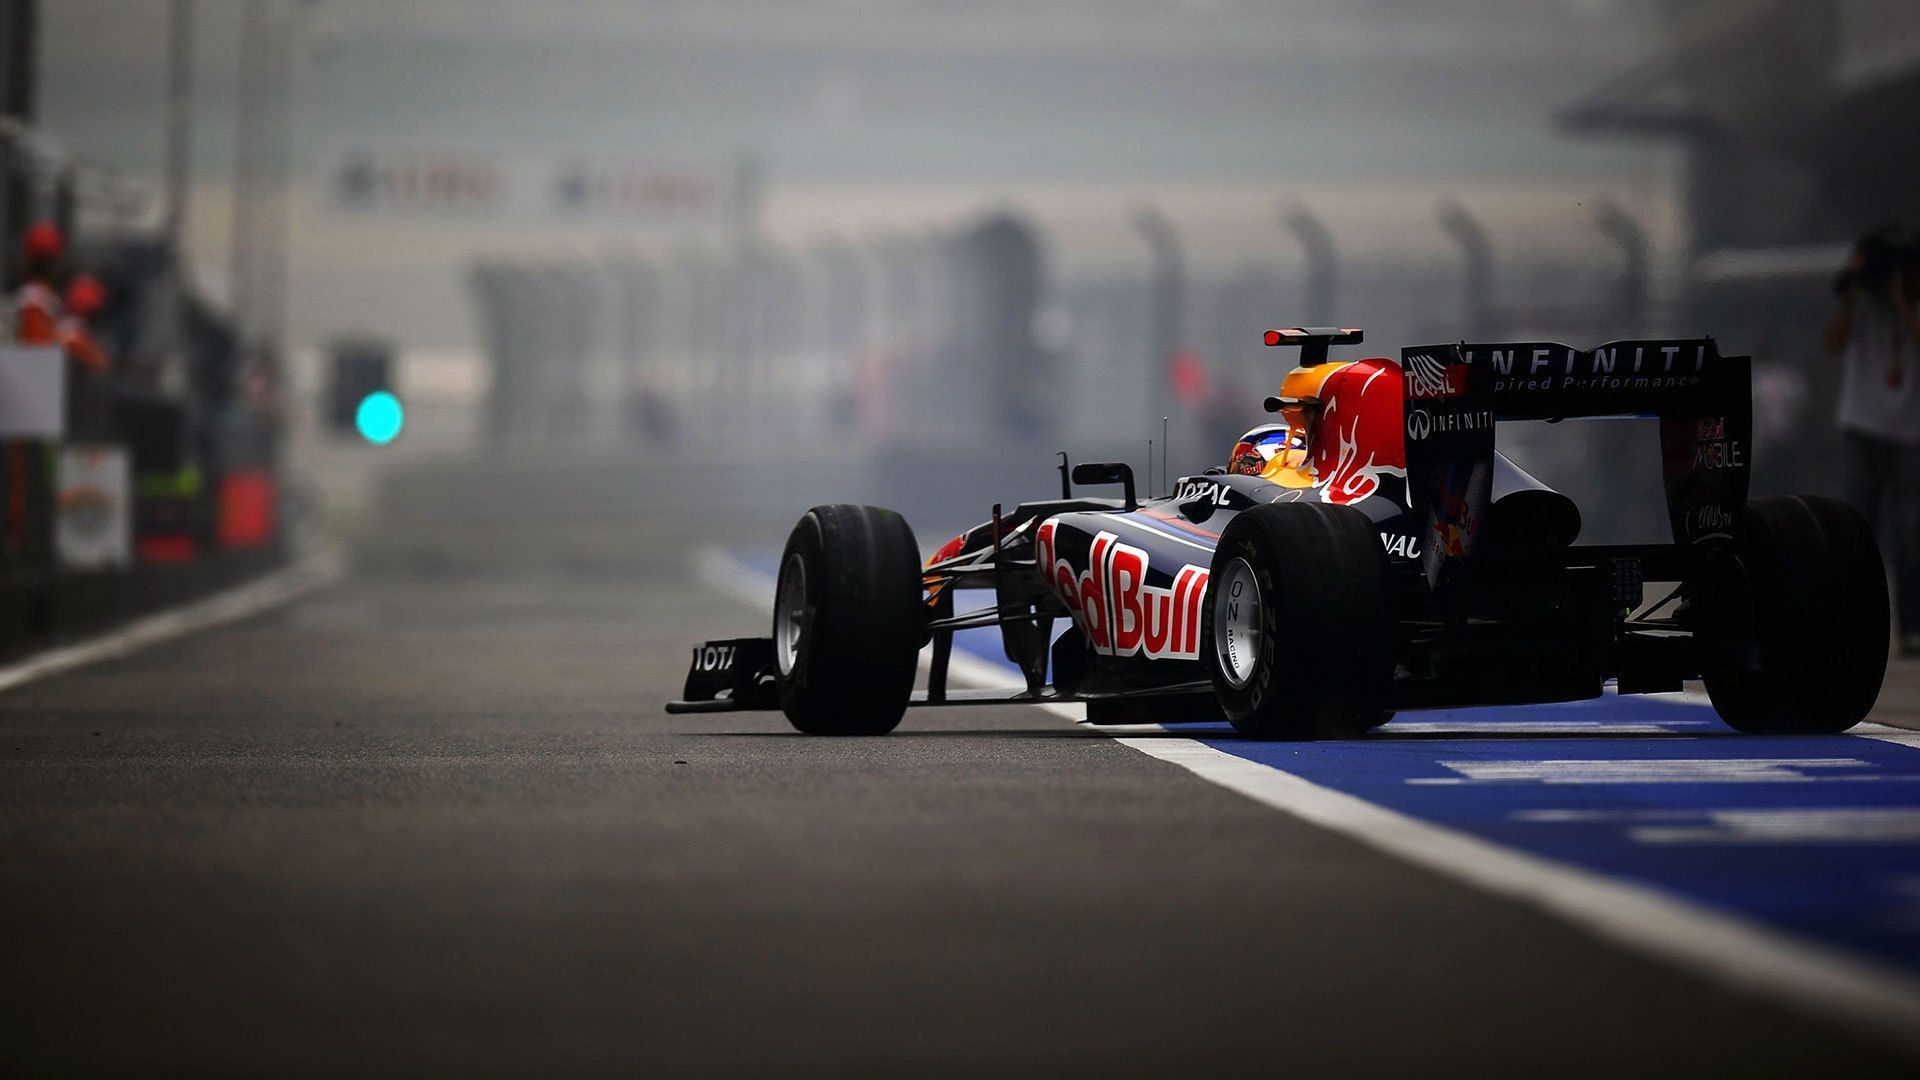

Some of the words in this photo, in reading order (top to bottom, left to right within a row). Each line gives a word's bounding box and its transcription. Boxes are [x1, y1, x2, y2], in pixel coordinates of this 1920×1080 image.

[1405, 371, 1456, 397] TOAL
[1494, 376, 1553, 393] pired
[1563, 375, 1700, 390] Performance
[1433, 411, 1493, 432] INFINITI
[1176, 476, 1231, 506] TOTAL
[1037, 519, 1115, 655] Red
[1110, 544, 1211, 658] Bull
[1227, 628, 1241, 669] RACING
